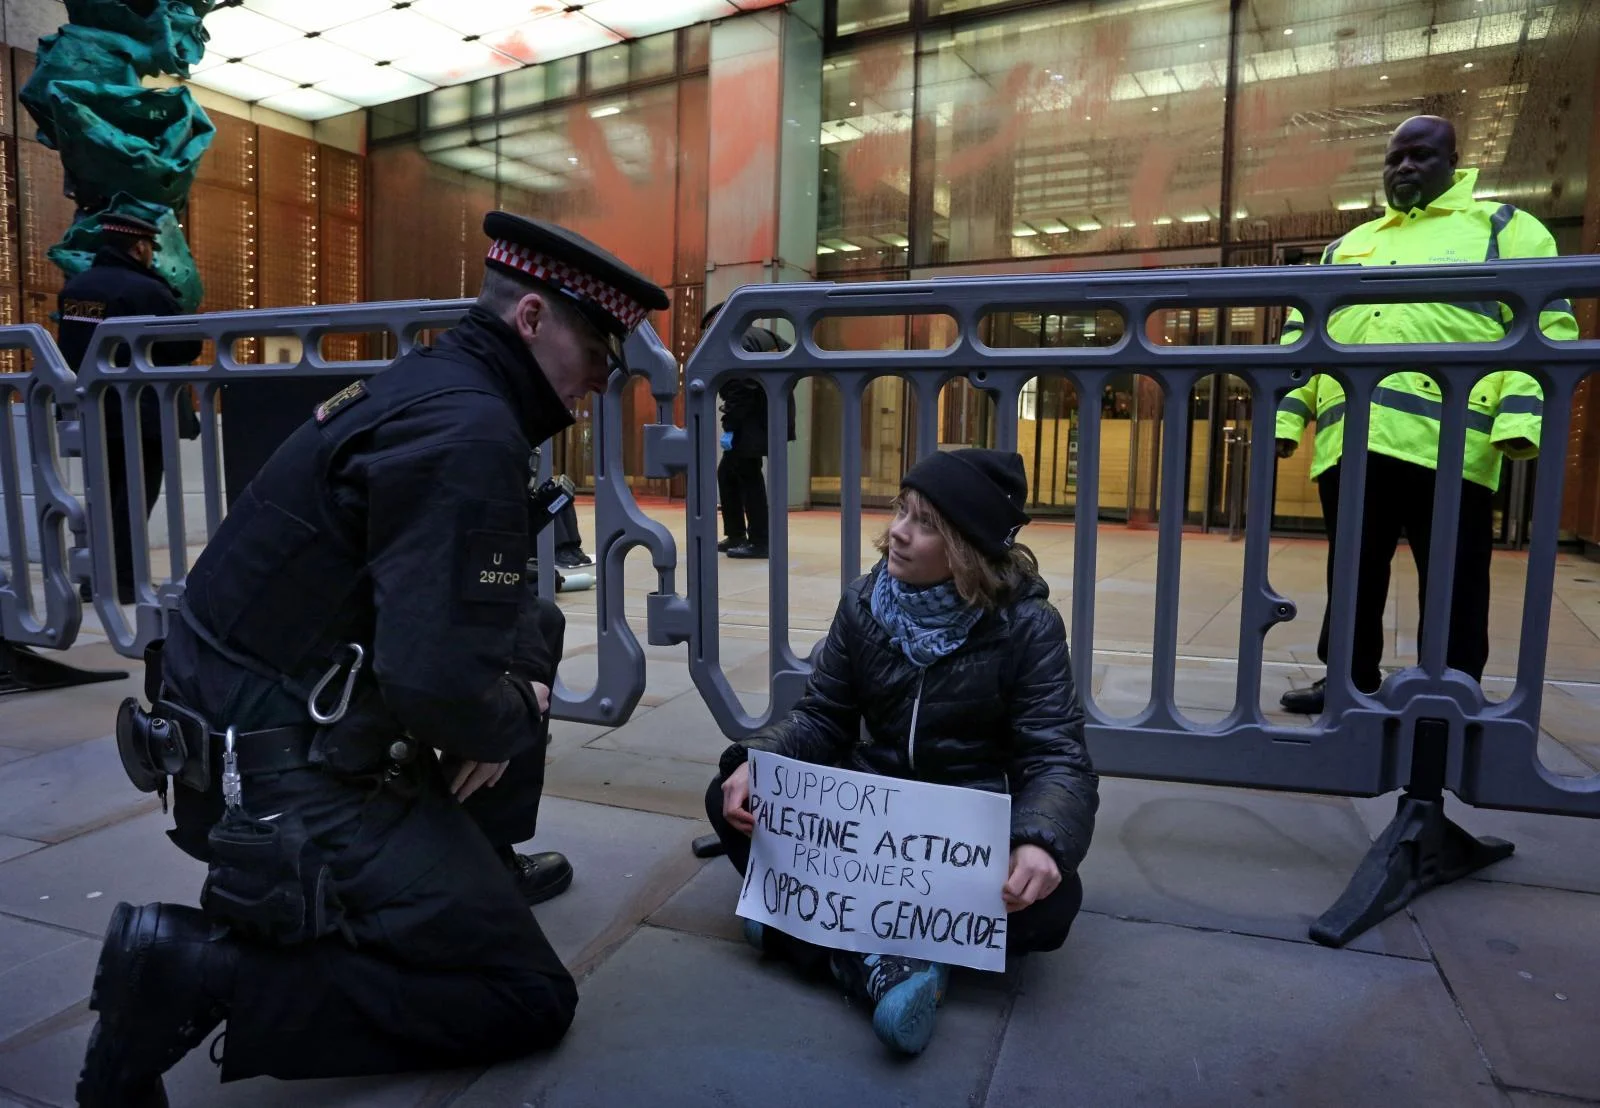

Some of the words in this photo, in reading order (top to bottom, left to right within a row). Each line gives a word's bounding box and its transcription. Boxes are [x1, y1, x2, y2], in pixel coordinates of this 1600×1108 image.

[480, 570, 520, 585] 297CP
[493, 552, 503, 565] U
[771, 765, 901, 816] SUPPORT
[750, 794, 861, 854] PALESTINE
[873, 831, 991, 868] ACTION
[793, 843, 933, 896] PRISONERS
[763, 868, 856, 932] OPPOSE
[871, 900, 1007, 950] GENOCIDE
